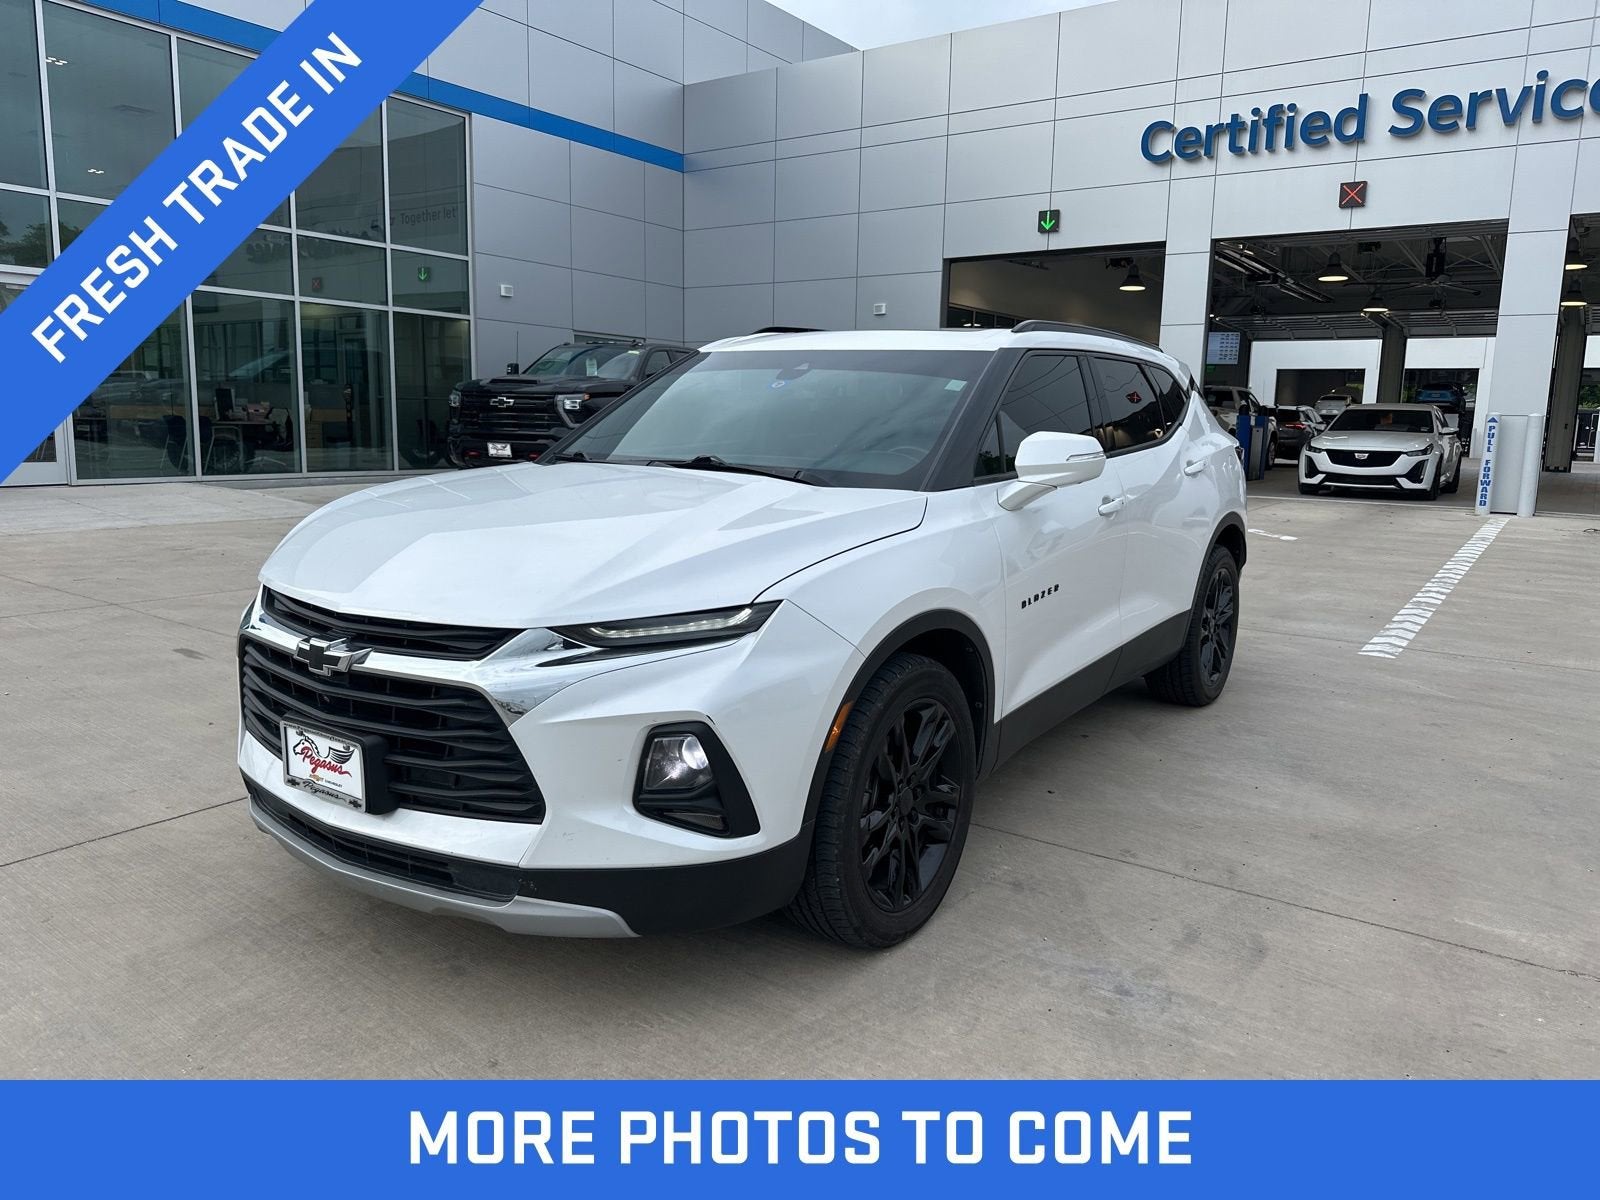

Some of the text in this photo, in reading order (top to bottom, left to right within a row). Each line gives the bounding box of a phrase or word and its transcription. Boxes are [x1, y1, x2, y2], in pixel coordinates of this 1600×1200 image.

[1140, 93, 1368, 163] Certified
[1478, 425, 1496, 507] PULL FORWARD
[1021, 583, 1060, 610] BLAZER
[300, 745, 353, 778] Pegasus
[302, 780, 347, 803] Pegasus
